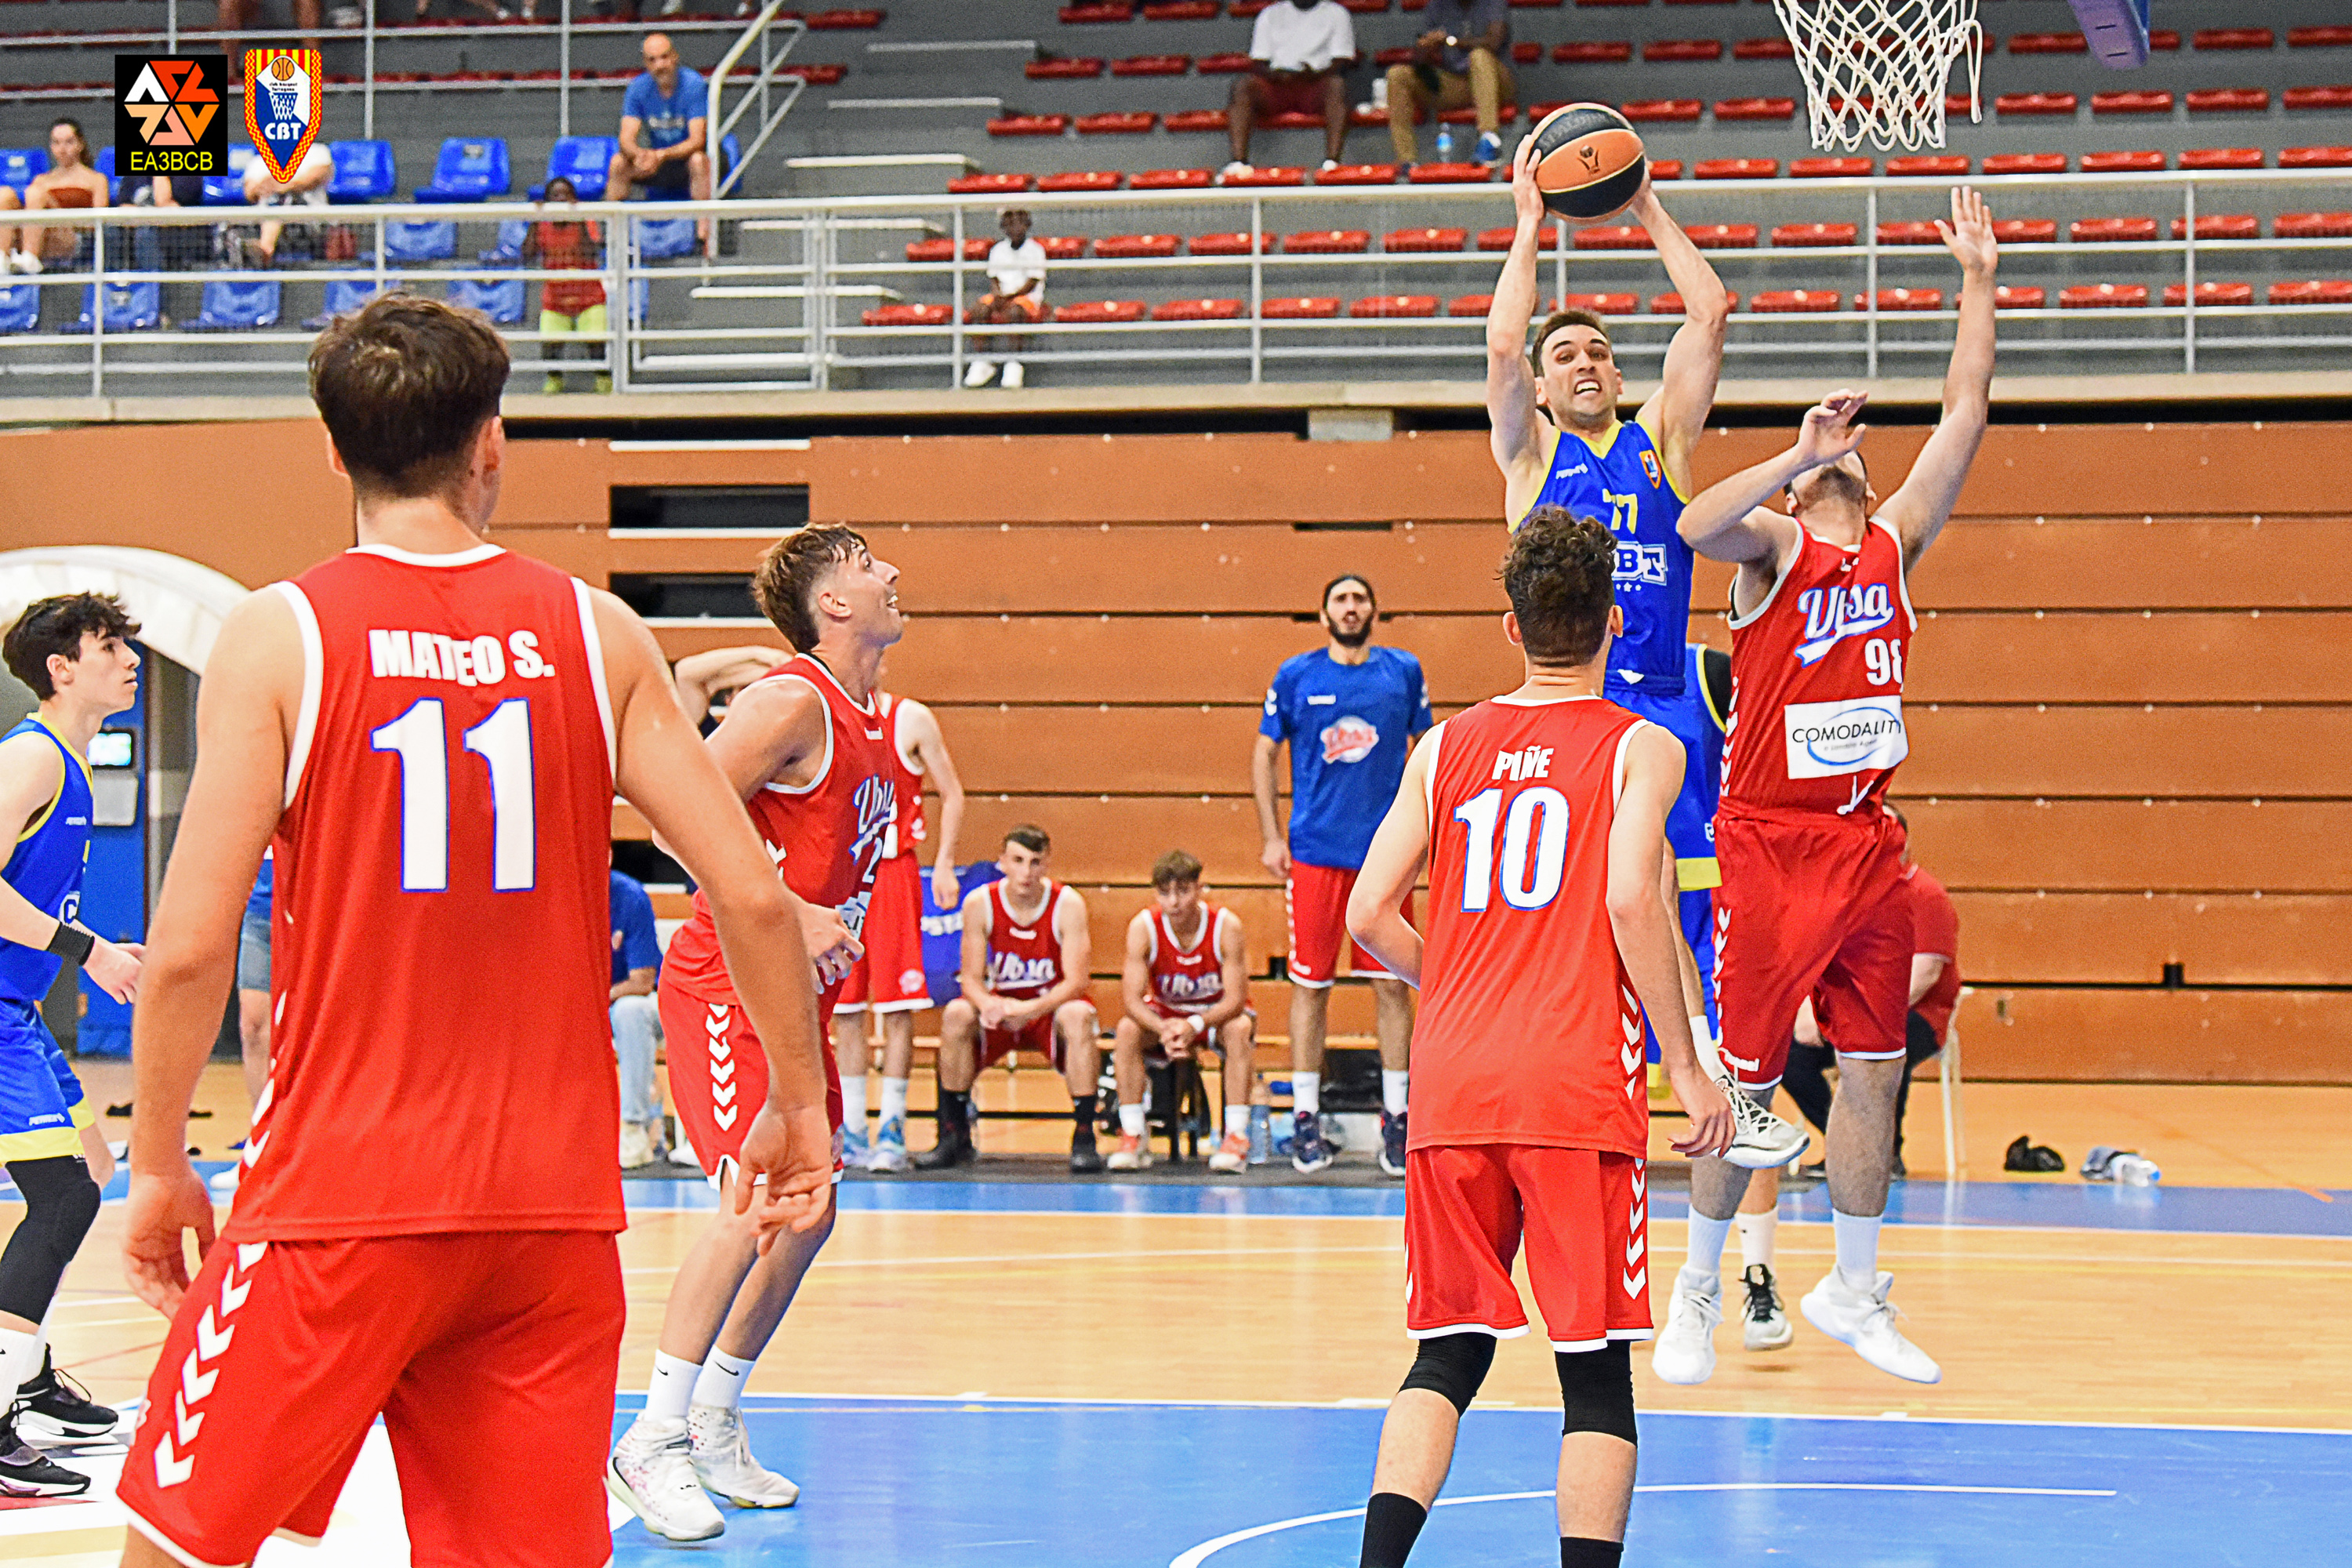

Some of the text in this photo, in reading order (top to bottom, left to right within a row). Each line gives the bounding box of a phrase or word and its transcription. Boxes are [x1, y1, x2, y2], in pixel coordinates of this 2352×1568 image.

[1611, 541, 1668, 586] BT
[368, 629, 556, 688] MATEO S.
[1491, 745, 1554, 782] PIÑE
[370, 697, 536, 894] 11
[1453, 786, 1570, 913] 10
